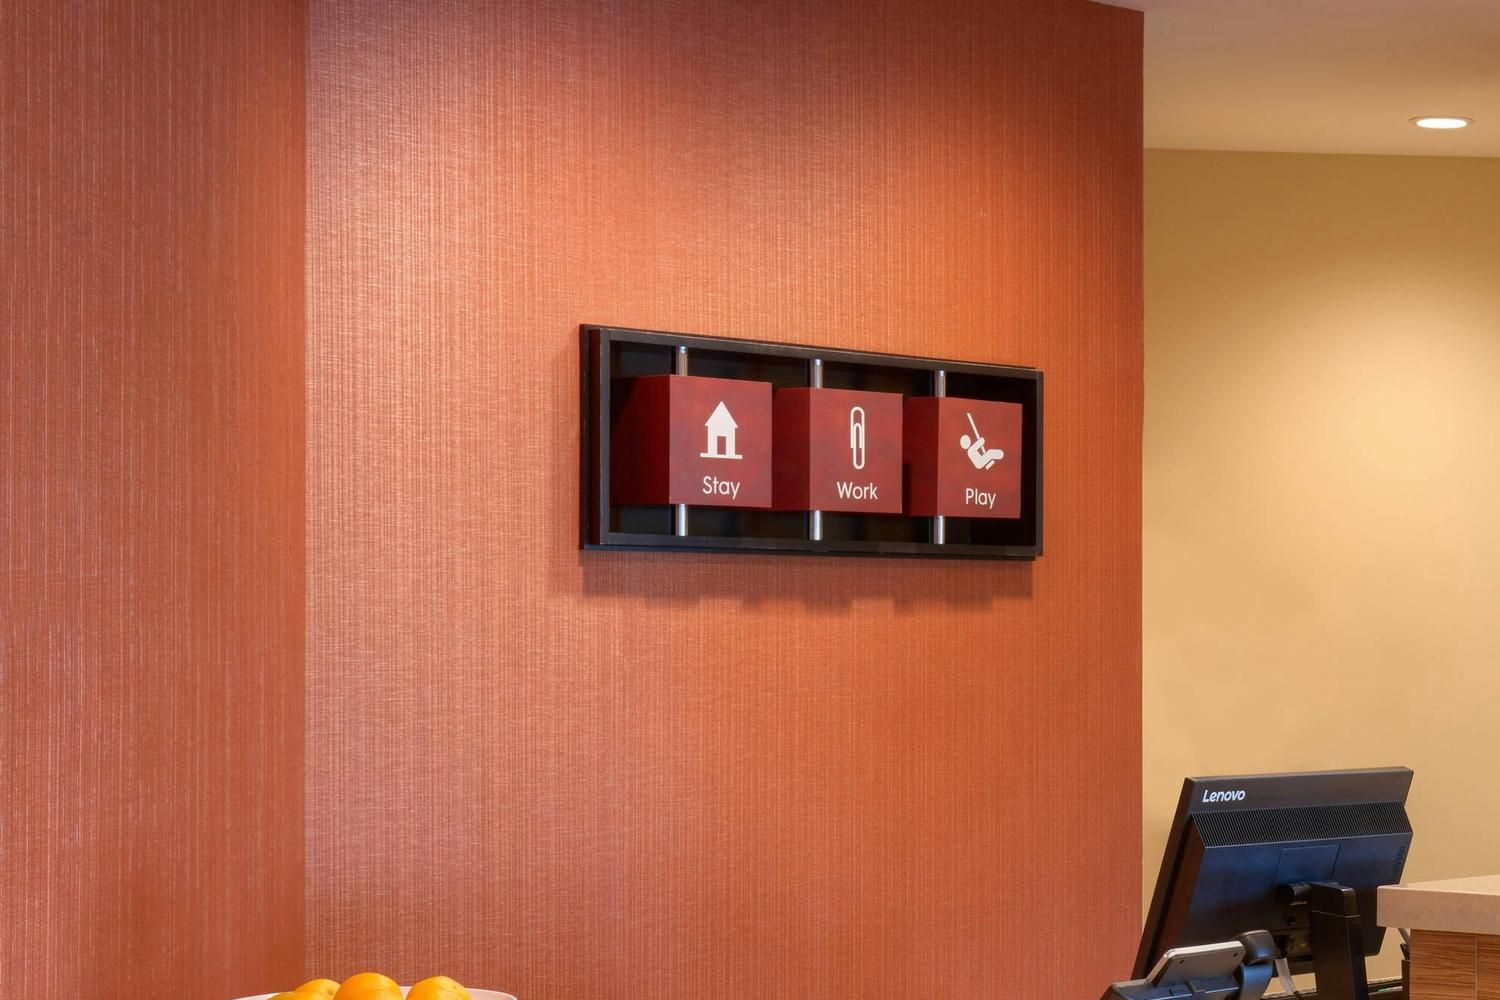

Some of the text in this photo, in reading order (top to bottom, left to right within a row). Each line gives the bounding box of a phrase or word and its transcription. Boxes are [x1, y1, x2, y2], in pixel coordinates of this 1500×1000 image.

[702, 475, 741, 500] Stay
[836, 481, 879, 501] Work
[965, 487, 996, 509] Play
[1202, 789, 1246, 803] Lenovo
